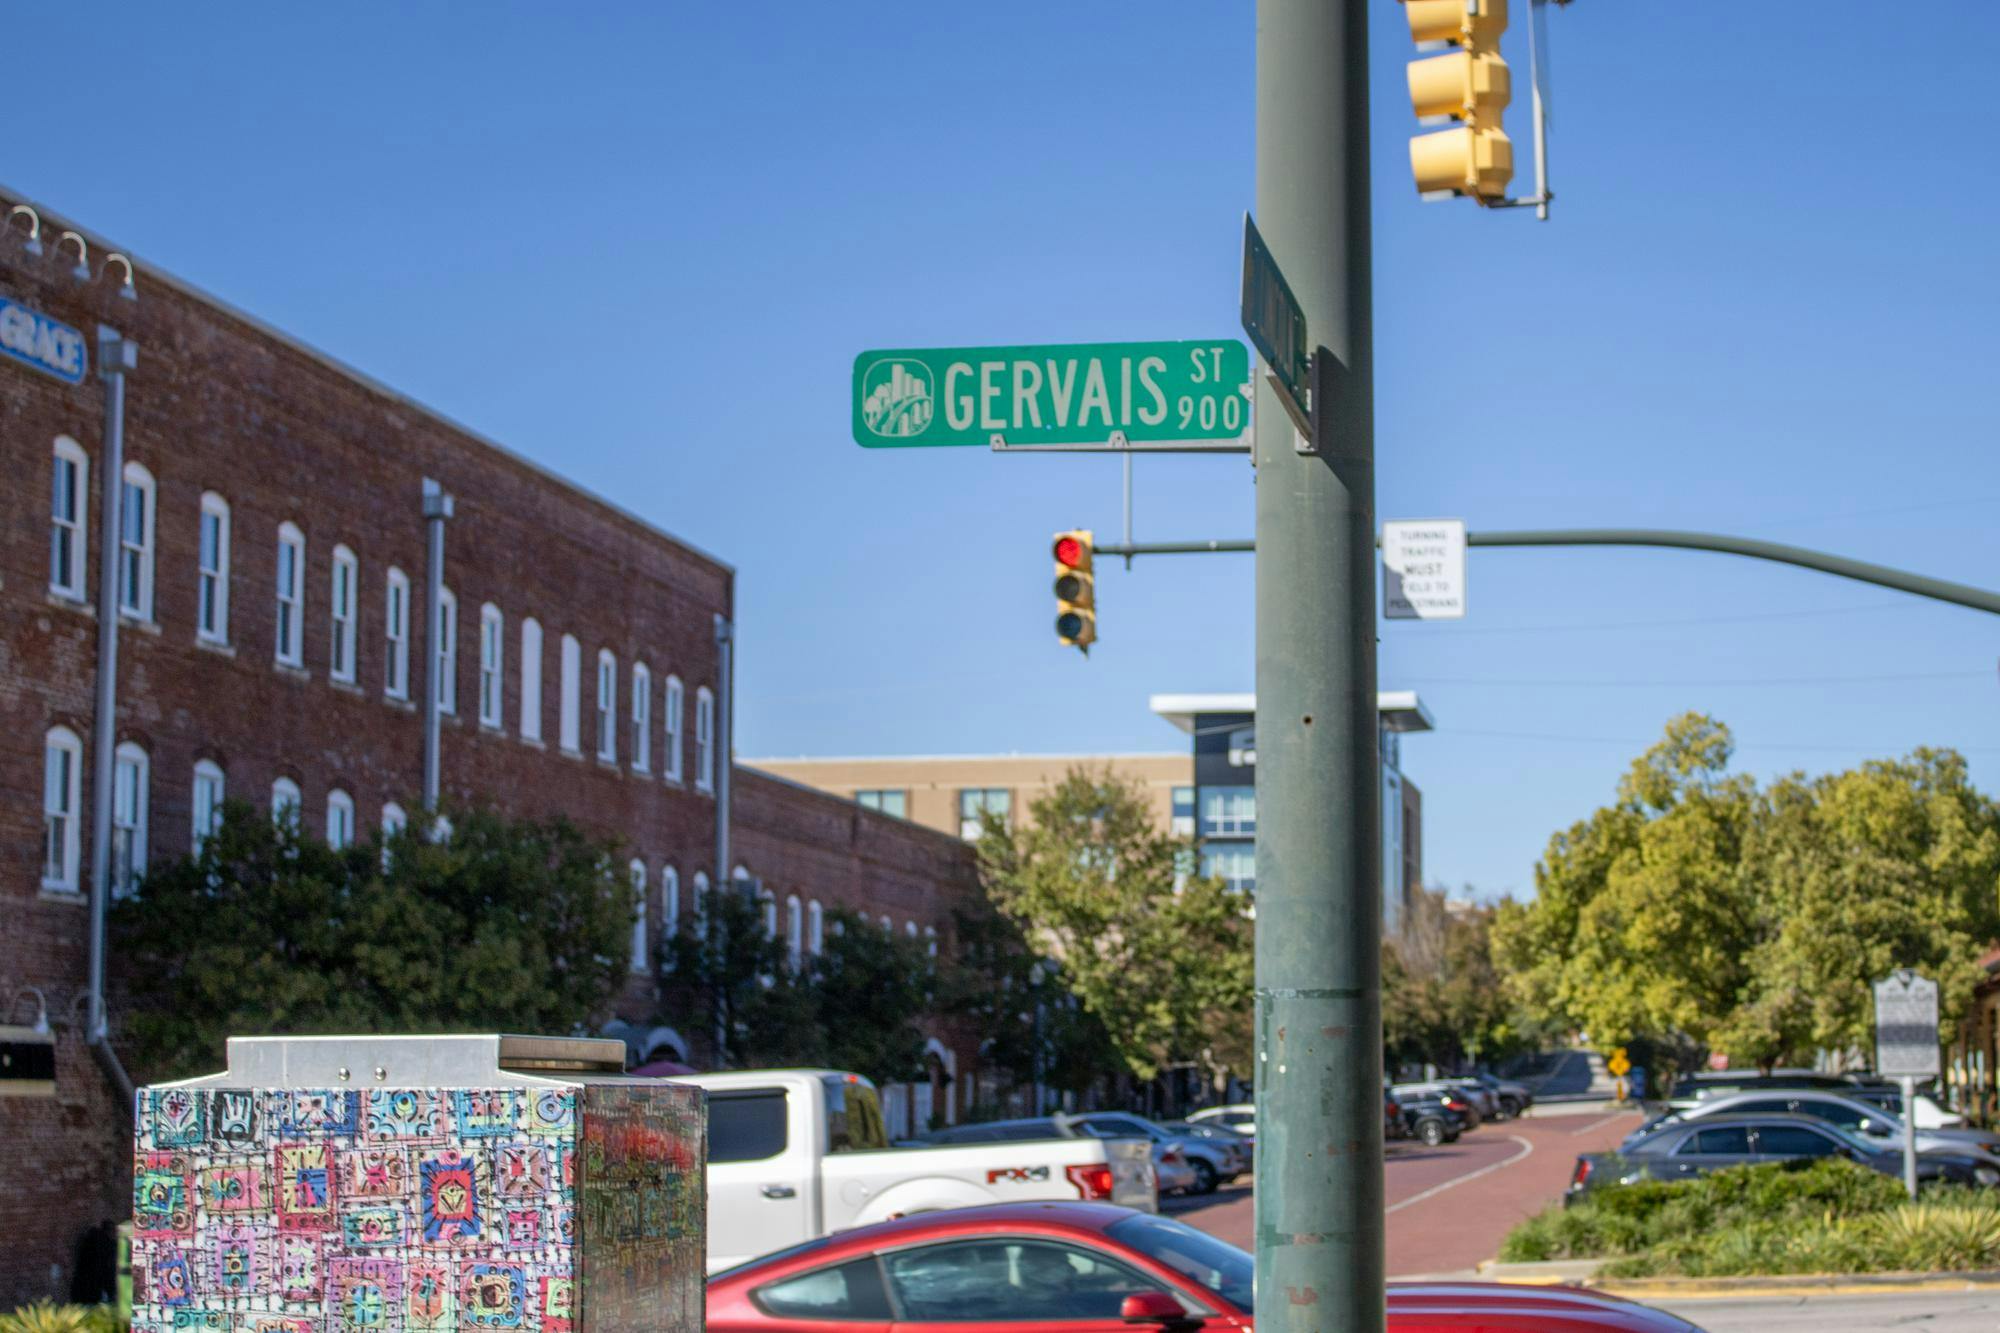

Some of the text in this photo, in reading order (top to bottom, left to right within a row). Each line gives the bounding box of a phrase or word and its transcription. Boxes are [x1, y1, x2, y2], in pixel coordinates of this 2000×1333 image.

[944, 347, 1225, 431] GERVAIS ST
[1178, 395, 1241, 431] 900
[1405, 563, 1443, 575] MUST
[987, 1166, 1050, 1184] FX4
